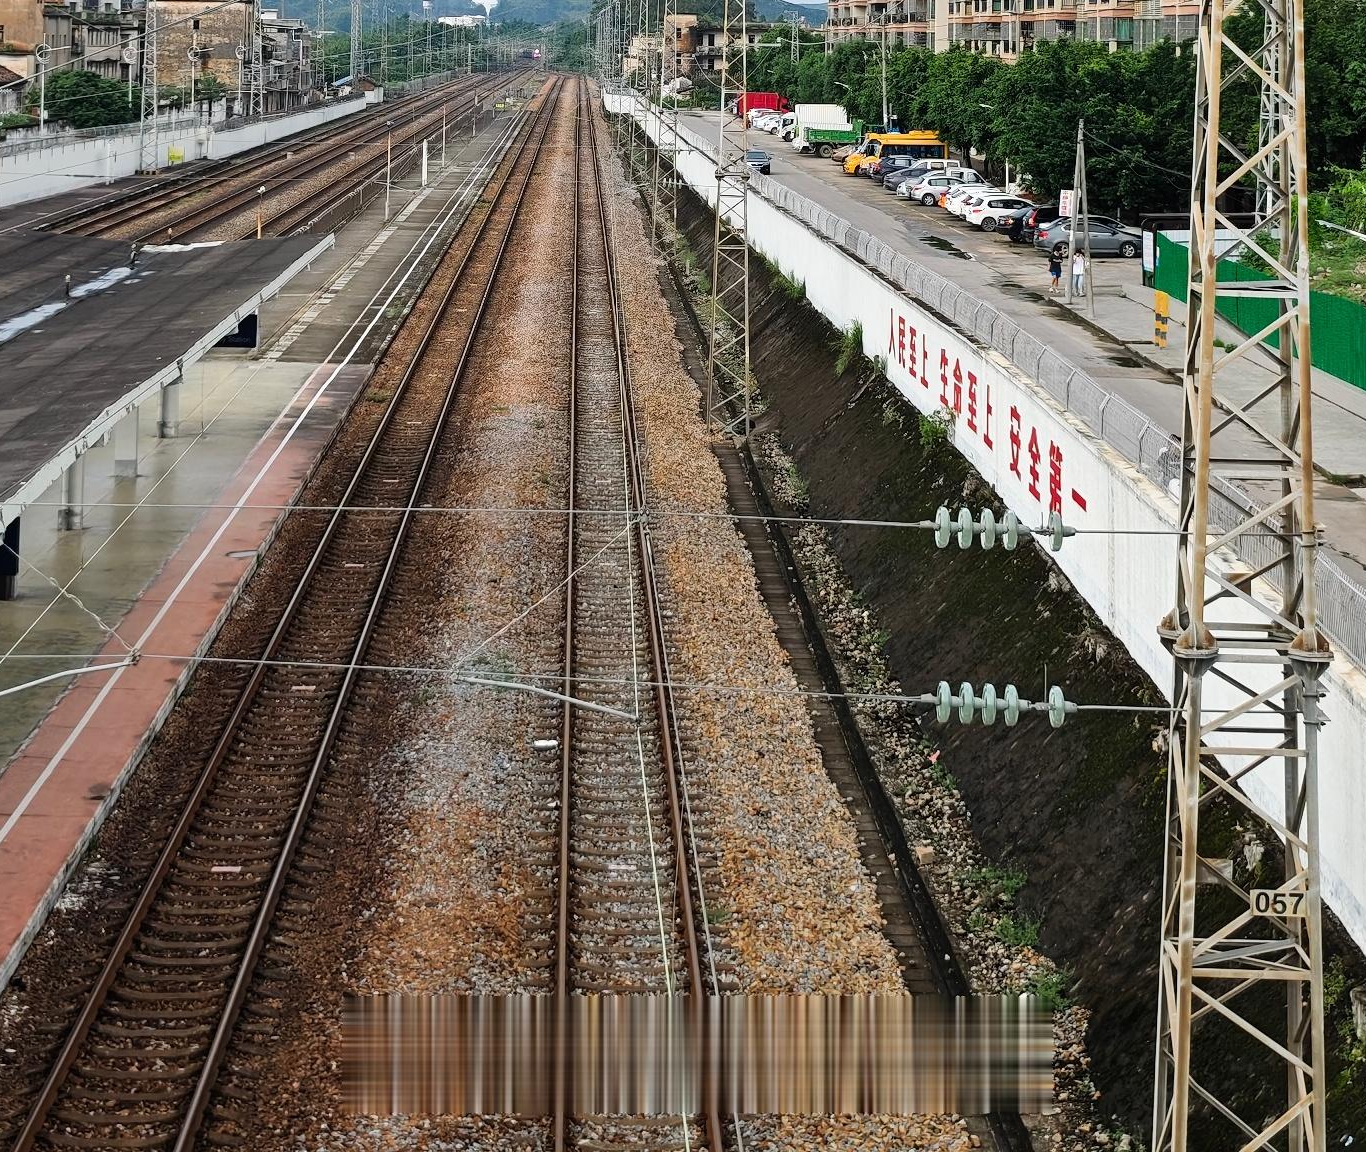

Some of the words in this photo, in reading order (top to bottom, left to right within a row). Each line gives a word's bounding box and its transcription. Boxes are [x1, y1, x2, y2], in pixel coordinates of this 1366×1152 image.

[888, 307, 929, 390] 人民至上
[939, 348, 993, 451] 生命至上
[1009, 404, 1087, 517] 安全第一
[1255, 891, 1304, 915] 057
